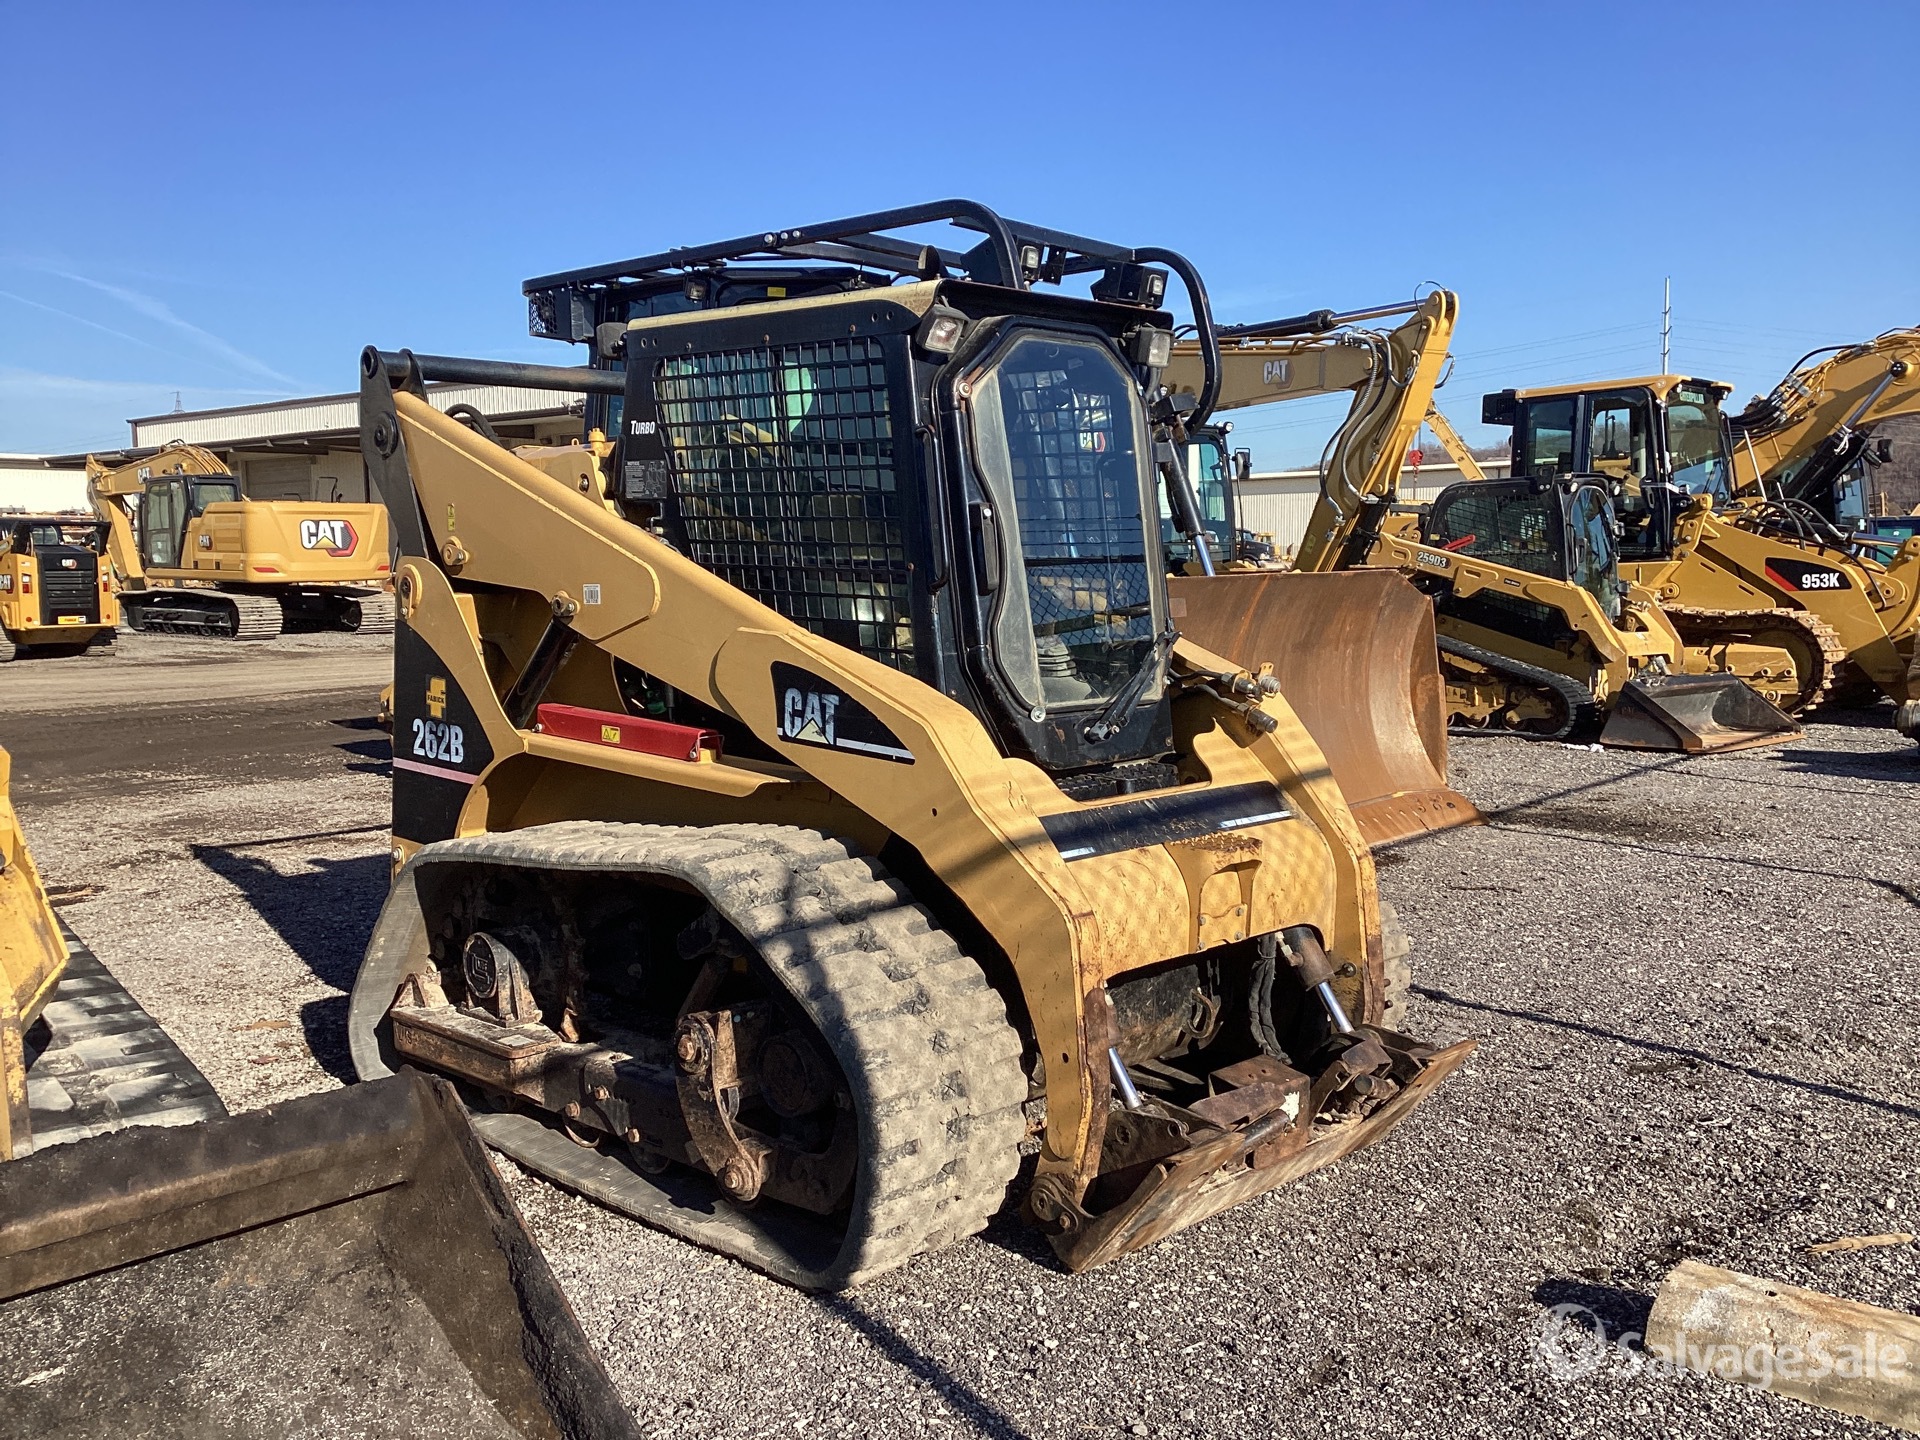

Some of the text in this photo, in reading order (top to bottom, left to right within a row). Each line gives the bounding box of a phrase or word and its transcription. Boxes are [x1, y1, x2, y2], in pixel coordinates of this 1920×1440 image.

[1263, 360, 1288, 384] CAT
[137, 466, 151, 484] CAT
[200, 534, 210, 547] CAT
[300, 520, 345, 549] CAT
[1416, 551, 1447, 568] 259D3
[1801, 572, 1840, 589] 953K
[427, 694, 445, 704] FABICK
[784, 687, 840, 745] CAT
[412, 718, 464, 764] 262B
